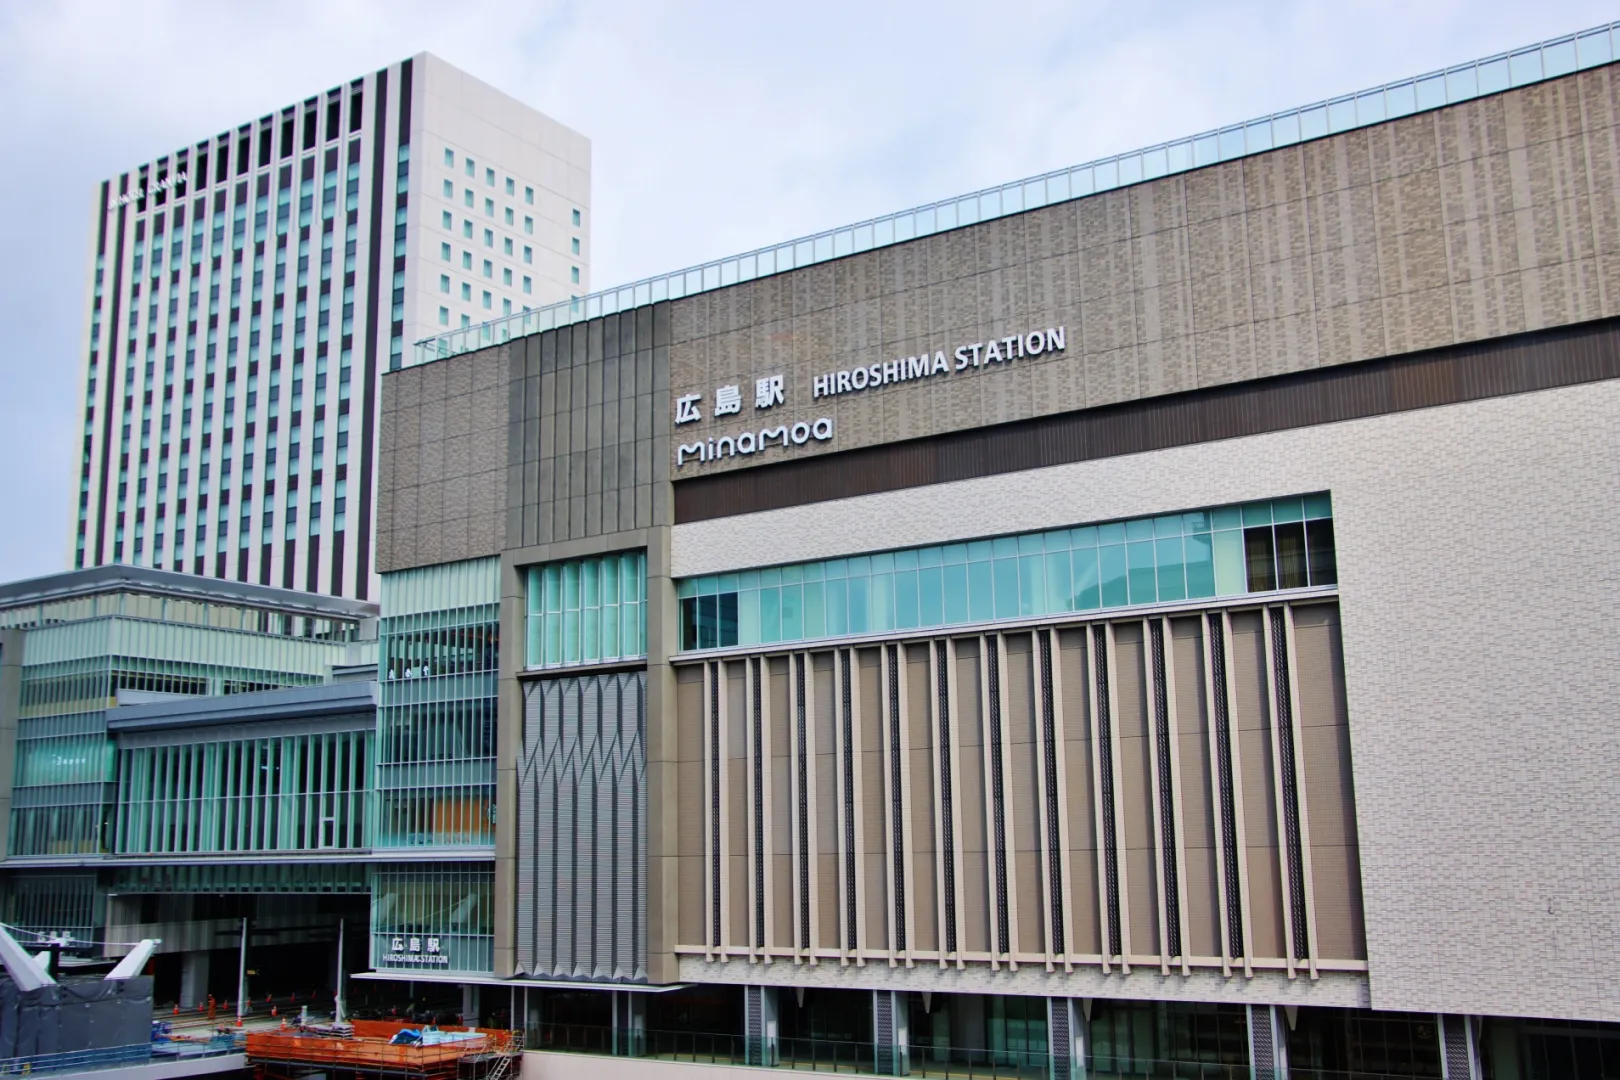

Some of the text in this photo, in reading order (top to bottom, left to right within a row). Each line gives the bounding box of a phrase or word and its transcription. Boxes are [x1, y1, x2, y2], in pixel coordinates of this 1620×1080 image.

[675, 326, 1066, 424] 広島駅 HIROSHIMA STATION
[391, 936, 441, 952] 広島駅
[382, 954, 448, 964] HIROSHIMA STATION
